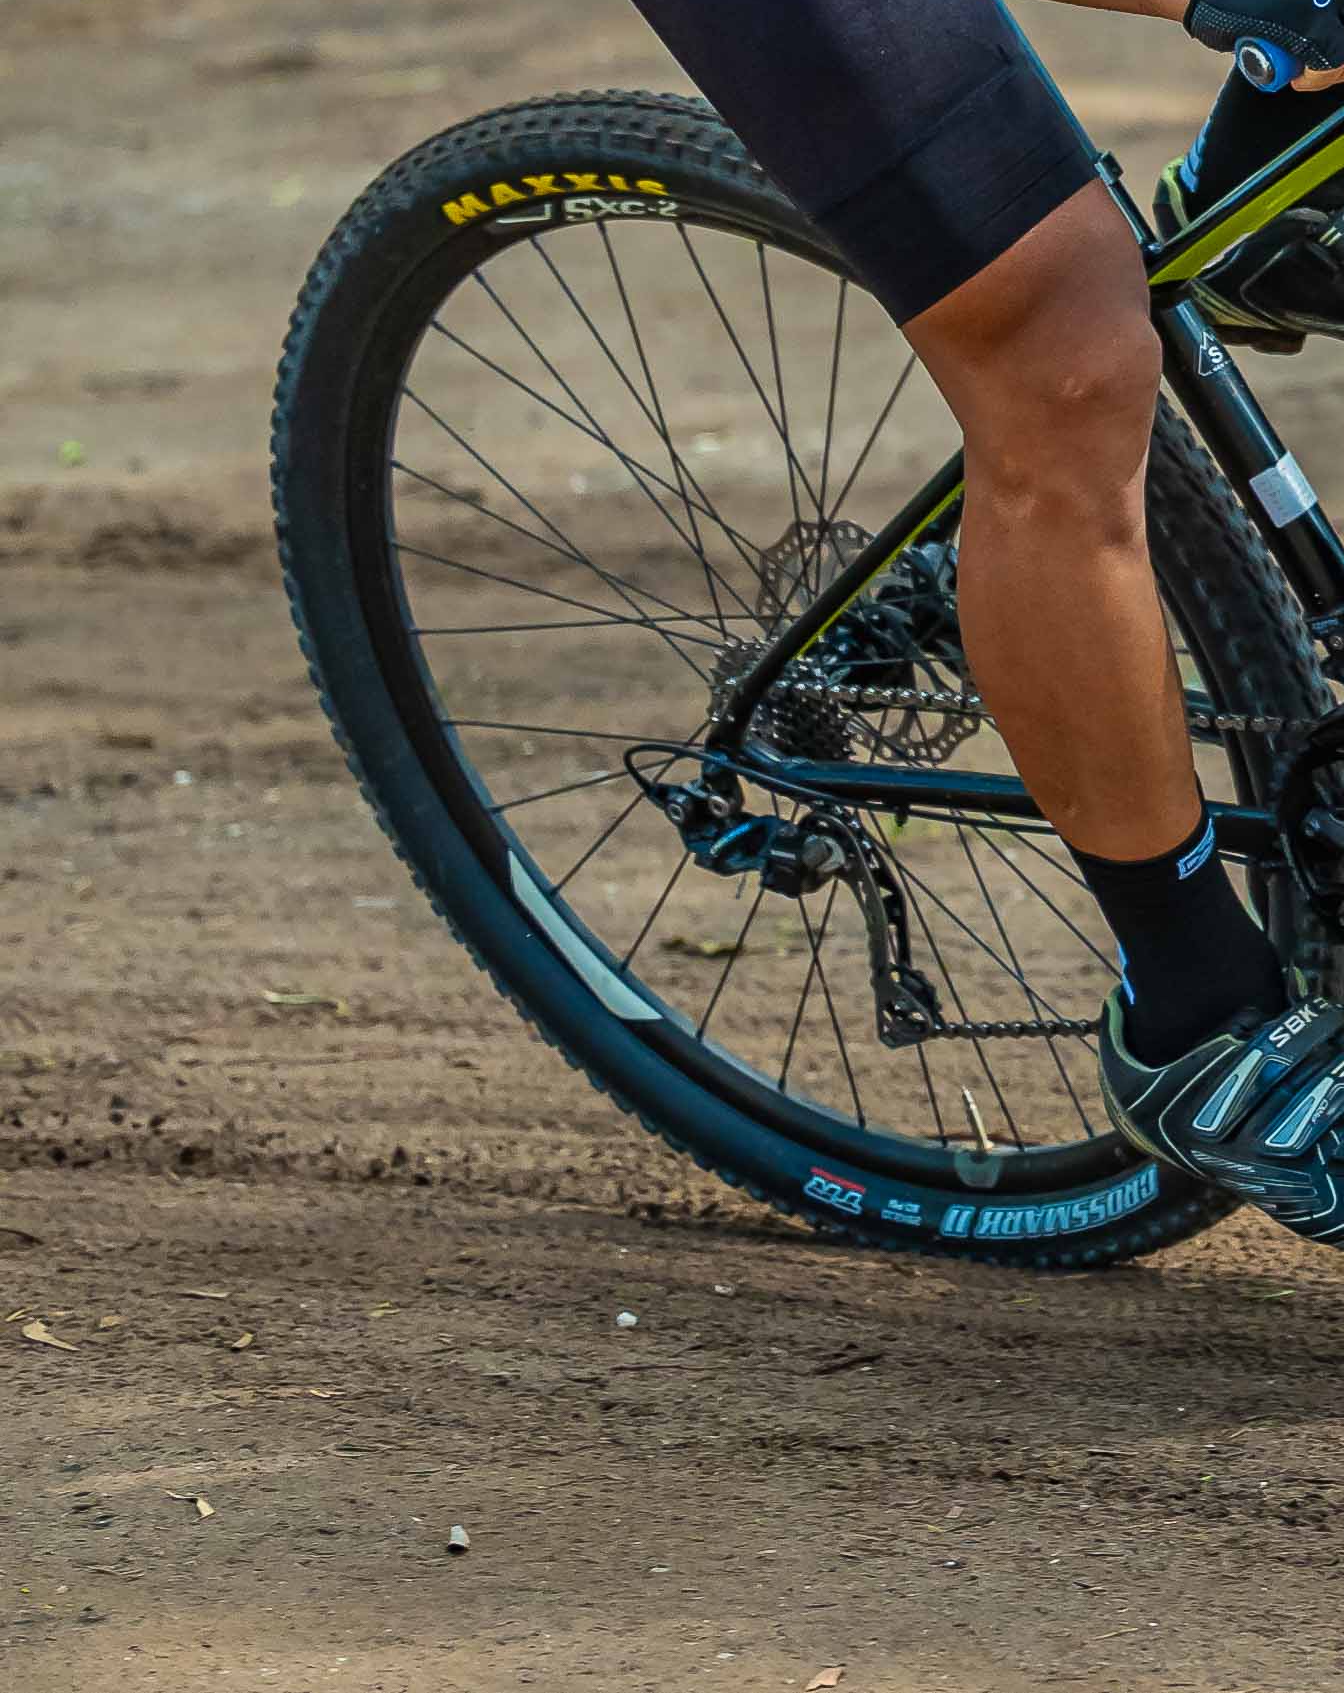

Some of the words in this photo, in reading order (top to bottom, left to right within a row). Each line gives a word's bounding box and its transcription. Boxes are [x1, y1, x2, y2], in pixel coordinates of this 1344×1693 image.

[441, 173, 672, 226] MAXXIS
[1268, 1003, 1320, 1049] SBK
[940, 1203, 977, 1239] II
[972, 1162, 1160, 1240] CROSSMARK
